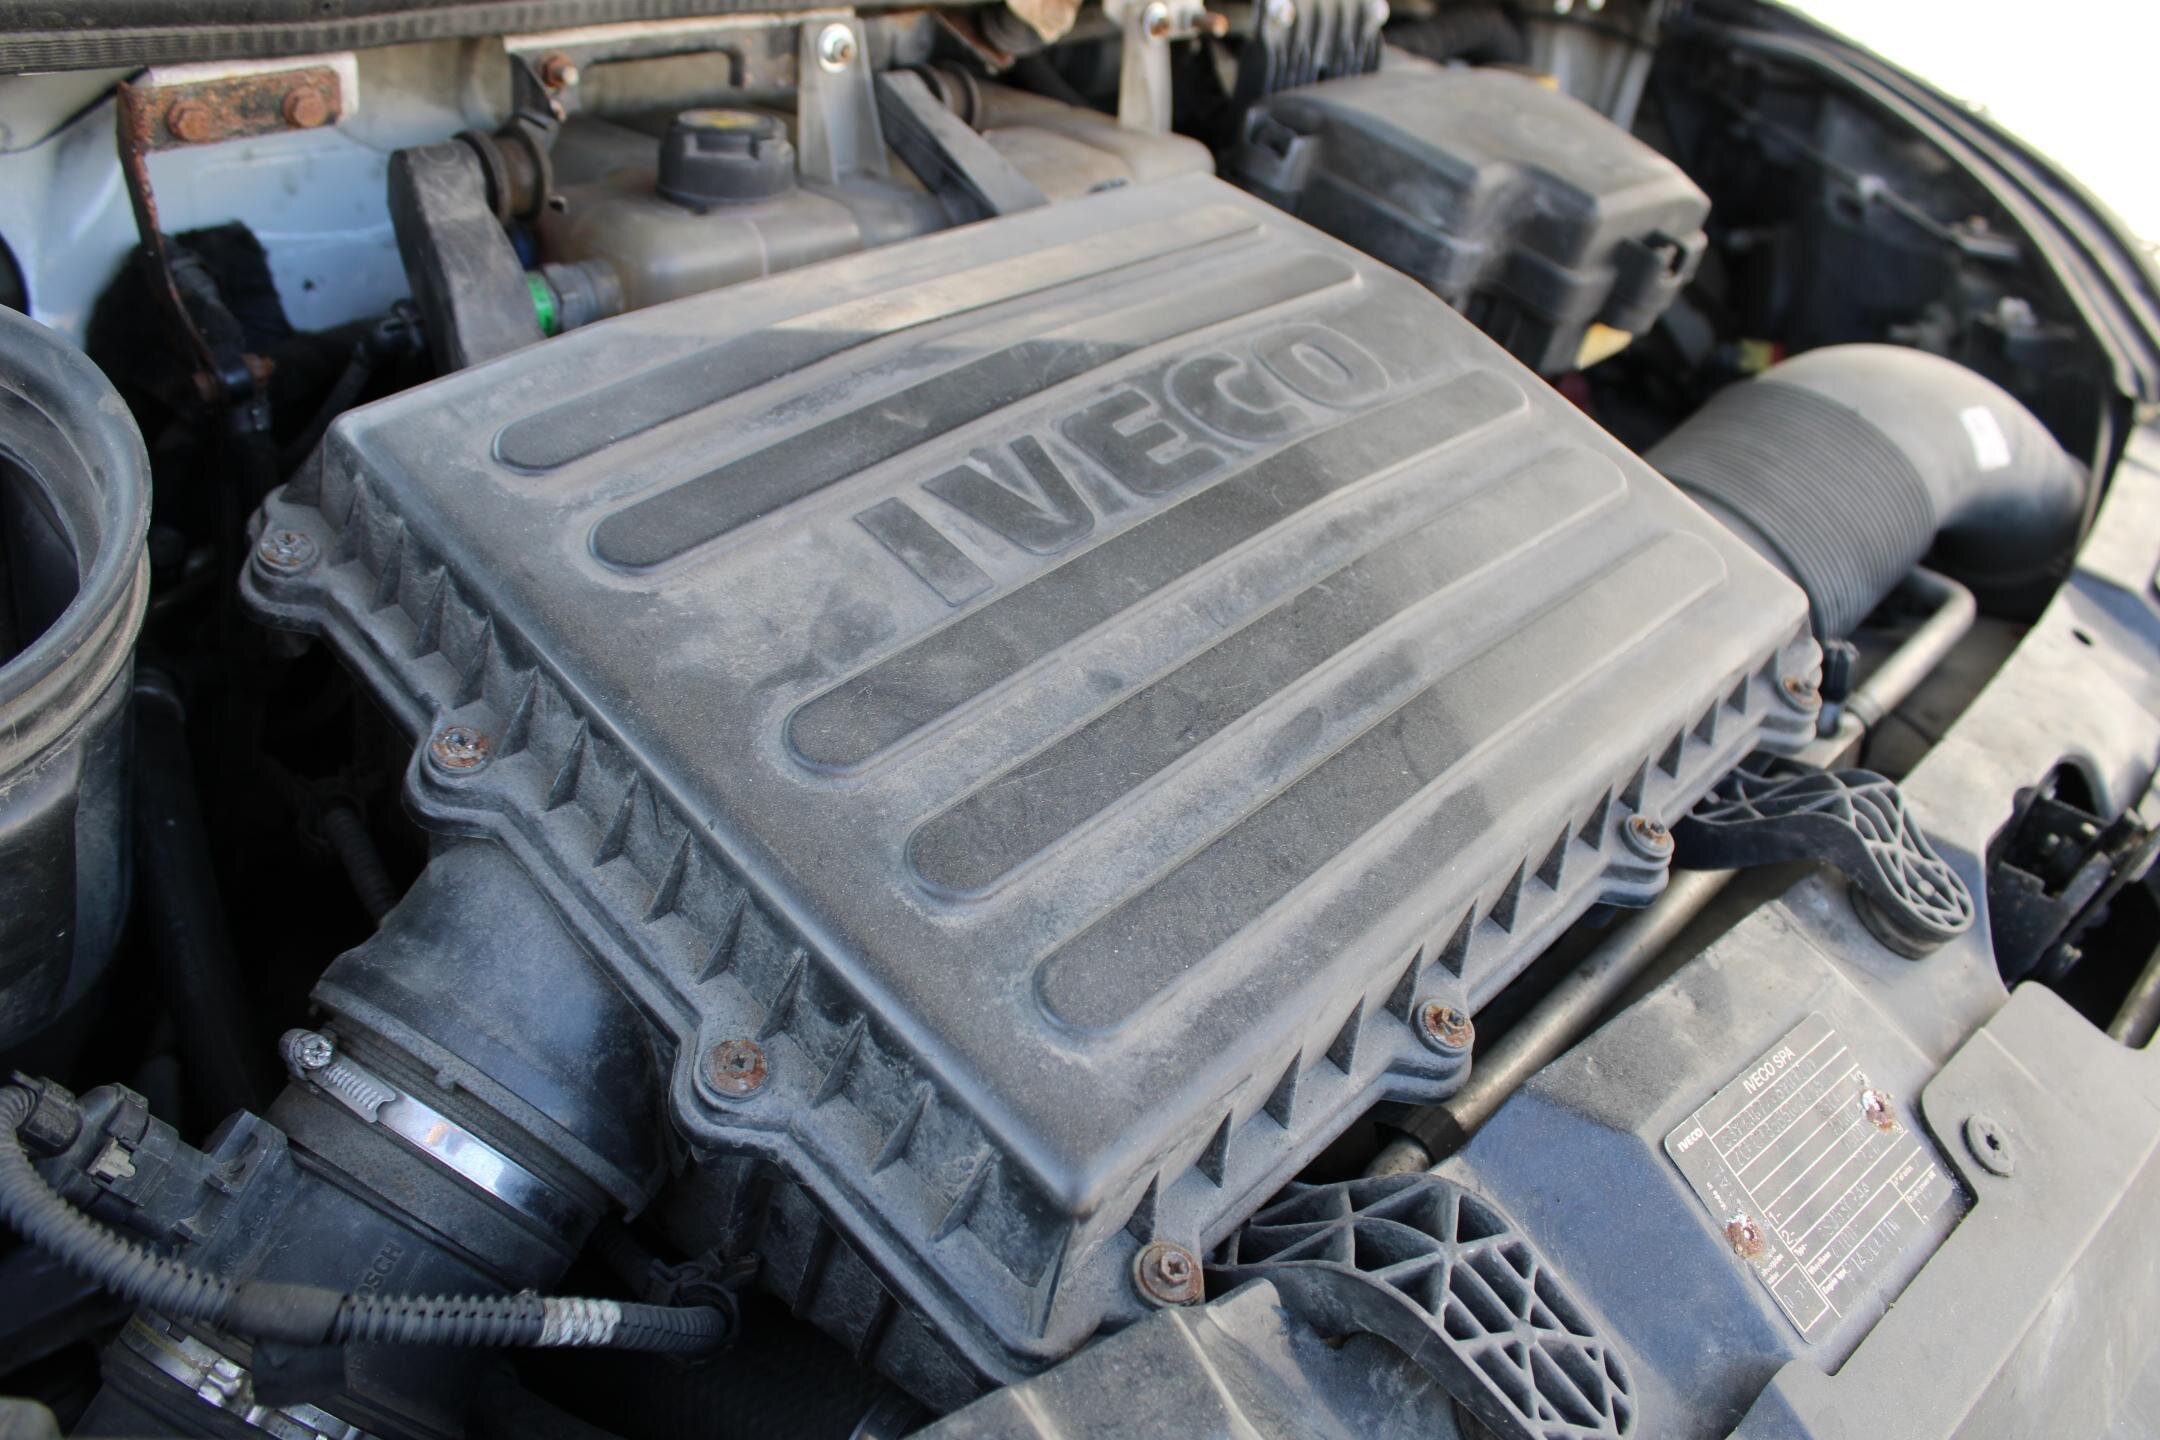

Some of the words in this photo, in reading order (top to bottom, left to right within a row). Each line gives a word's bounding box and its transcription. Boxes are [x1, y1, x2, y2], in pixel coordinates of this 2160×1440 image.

[852, 322, 1392, 608] IVECO
[1742, 1061, 1777, 1095] IVECO
[1772, 1046, 1797, 1070] SPA
[1677, 1127, 1704, 1153] IVECO
[358, 1239, 405, 1300] OSCH
